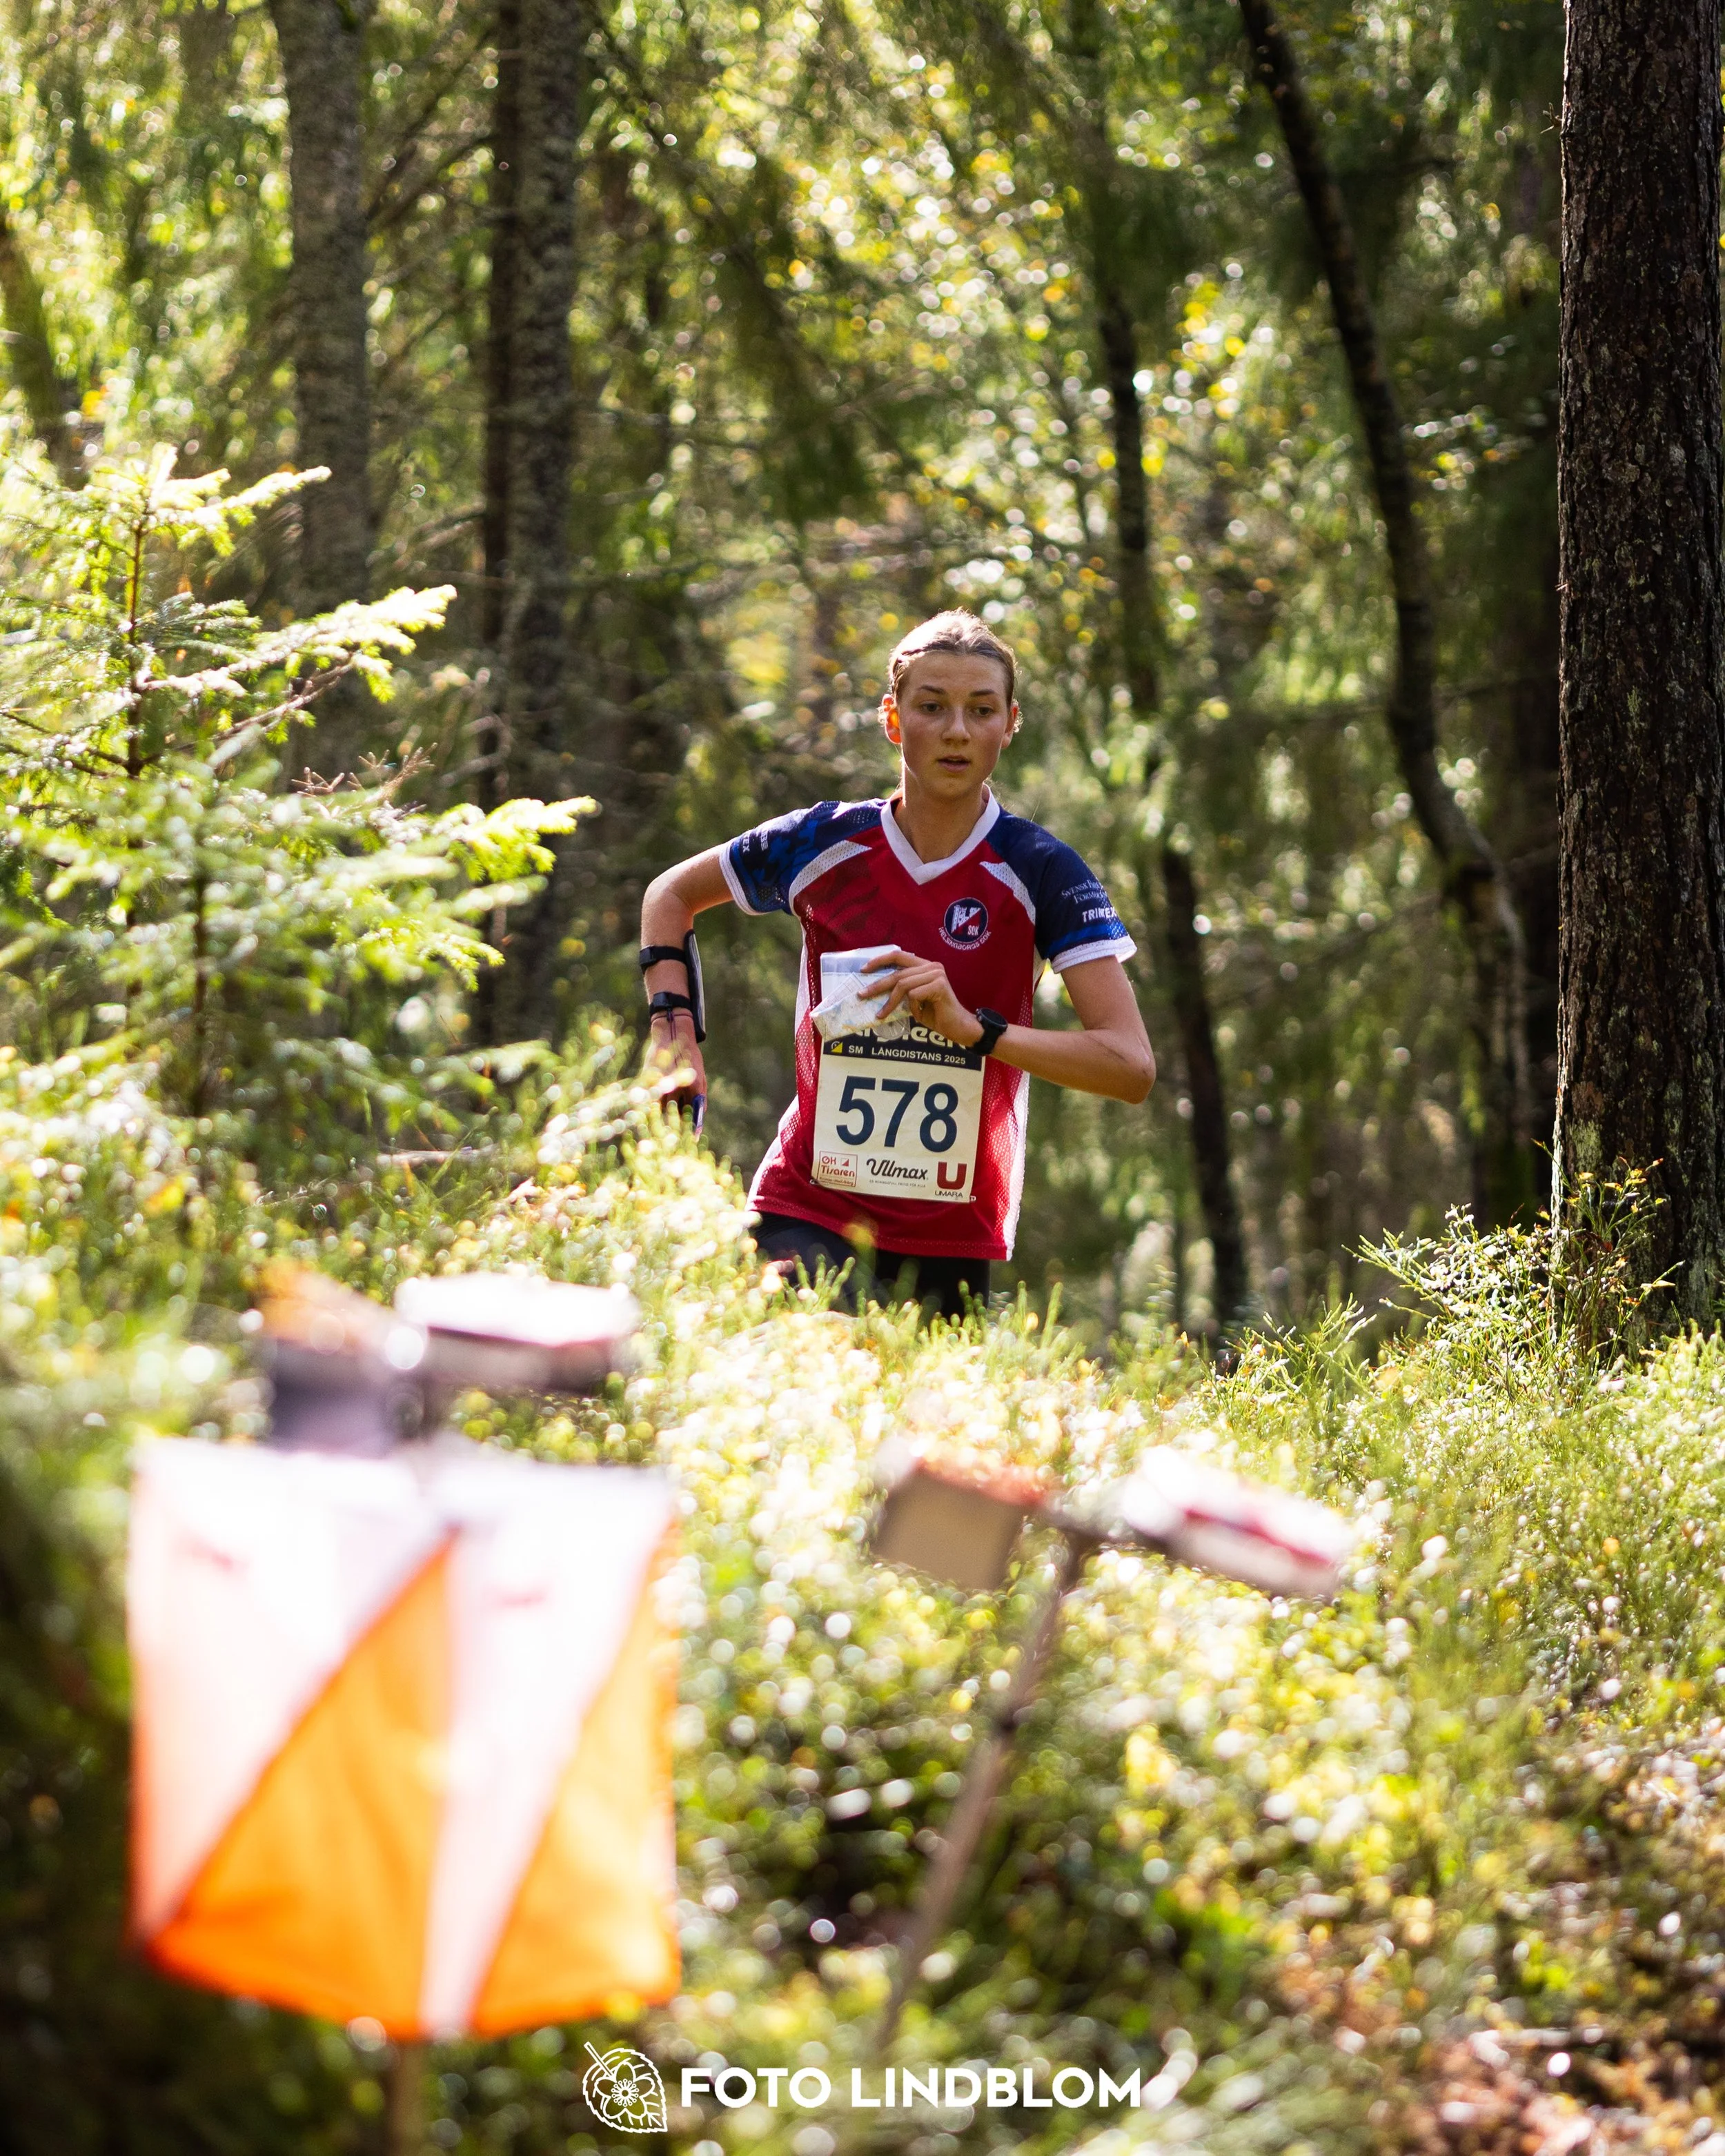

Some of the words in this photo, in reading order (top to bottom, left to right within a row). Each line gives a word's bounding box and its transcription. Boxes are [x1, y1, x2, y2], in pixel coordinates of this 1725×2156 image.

[849, 1045, 863, 1054] SM
[871, 1047, 942, 1061] LÅNGDISTANS
[944, 1055, 966, 1065] 2025
[836, 1075, 959, 1153] 578
[821, 1165, 855, 1178] Tisaren
[866, 1158, 928, 1180] Ullmax
[937, 1161, 967, 1190] U
[935, 1190, 963, 1198] UMARA
